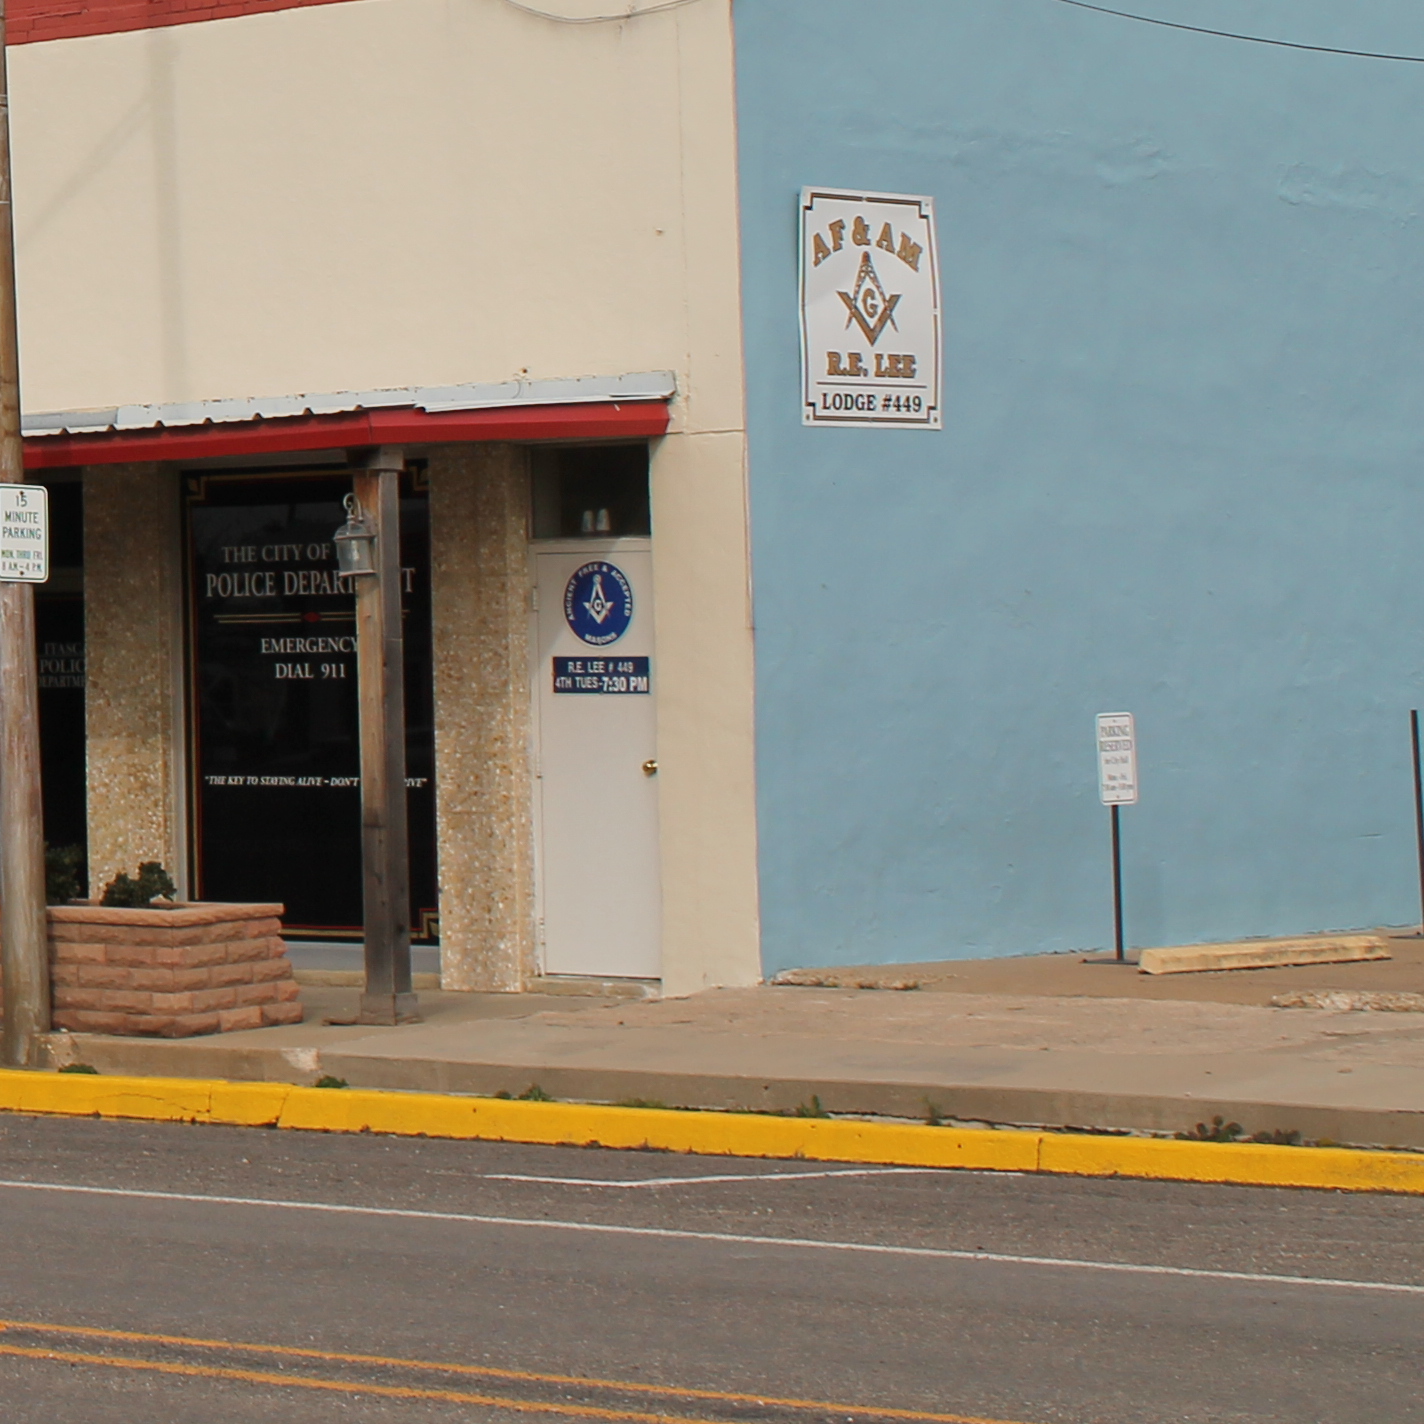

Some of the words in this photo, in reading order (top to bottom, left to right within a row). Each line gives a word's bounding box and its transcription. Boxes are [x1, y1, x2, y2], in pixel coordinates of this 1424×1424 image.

[813, 219, 846, 268] AF
[852, 216, 871, 247] &
[876, 222, 924, 273] AM
[862, 288, 878, 319] G
[826, 351, 869, 377] R.E.
[874, 353, 917, 378] LEE
[822, 392, 877, 411] LODGE
[882, 394, 922, 413] #449
[16, 495, 28, 507] 15
[5, 511, 39, 524] MINUTE
[2, 527, 42, 540] PARKING
[222, 546, 257, 563] THE
[262, 544, 303, 562] CITY
[307, 543, 331, 560] OF
[578, 564, 599, 577] FREE
[601, 564, 609, 573] &
[206, 572, 277, 597] POLICE
[565, 579, 578, 621] ANCIENT
[611, 569, 631, 617] ACCEPTED
[594, 599, 602, 611] G
[584, 631, 618, 645] MASONS
[275, 663, 314, 679] DIAL
[321, 663, 346, 679] 911
[587, 661, 605, 673] LEE
[617, 661, 634, 673] 449
[555, 676, 572, 688] 4TH
[629, 676, 648, 692] PM
[227, 776, 244, 785] KEY
[247, 776, 258, 785] TO
[260, 776, 296, 785] STAYING
[297, 776, 323, 786] ALIVE
